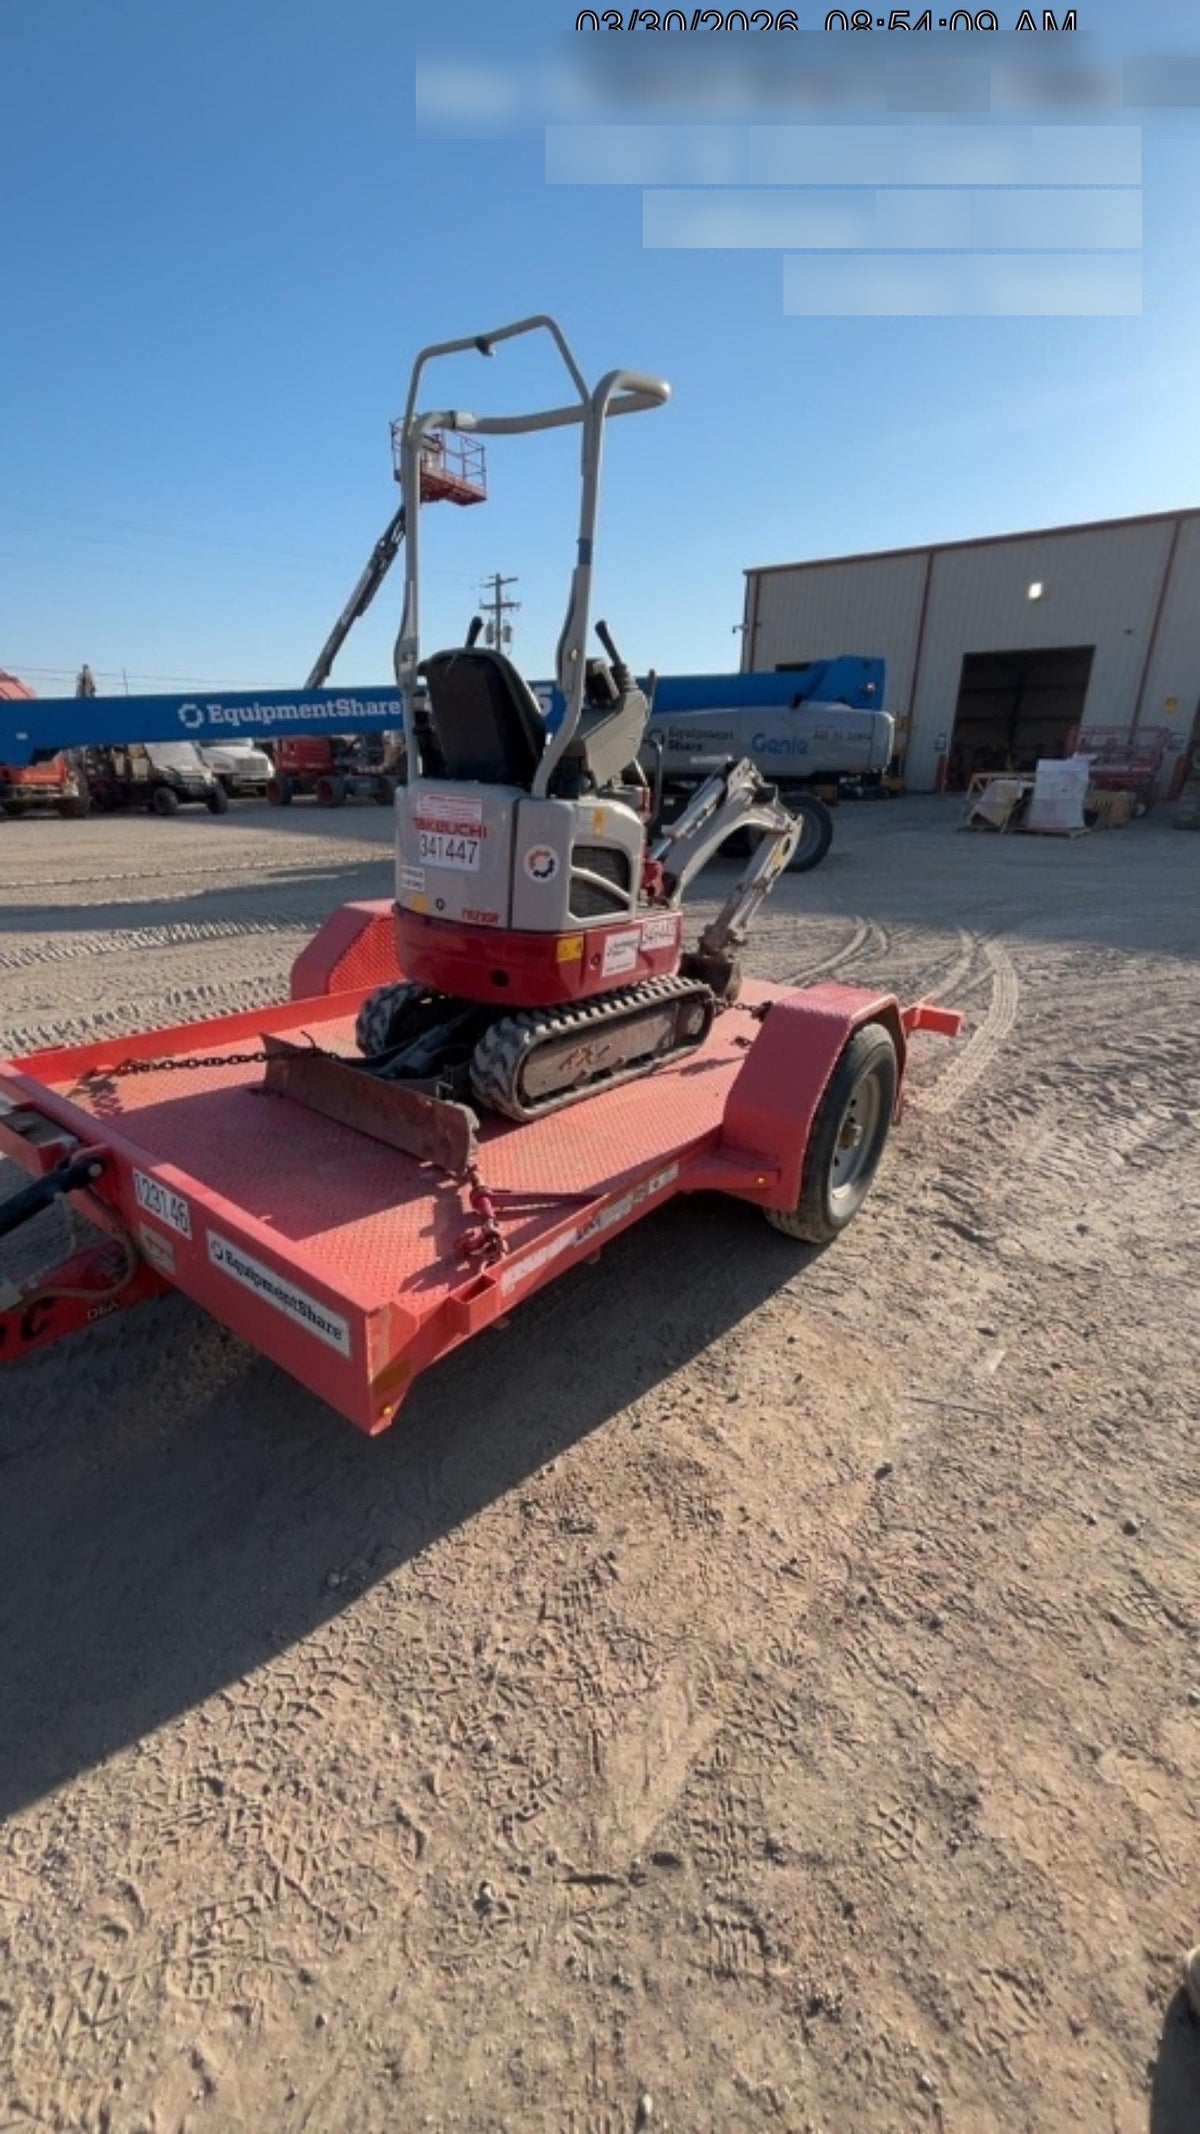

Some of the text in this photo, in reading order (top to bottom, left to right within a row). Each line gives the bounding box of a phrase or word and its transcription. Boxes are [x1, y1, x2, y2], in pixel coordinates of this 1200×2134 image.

[205, 698, 402, 727] EquipmentShare
[751, 732, 809, 755] Genie
[420, 833, 479, 865] 341447
[134, 1172, 189, 1234] 123146
[224, 1248, 343, 1341] EquipmentShare
